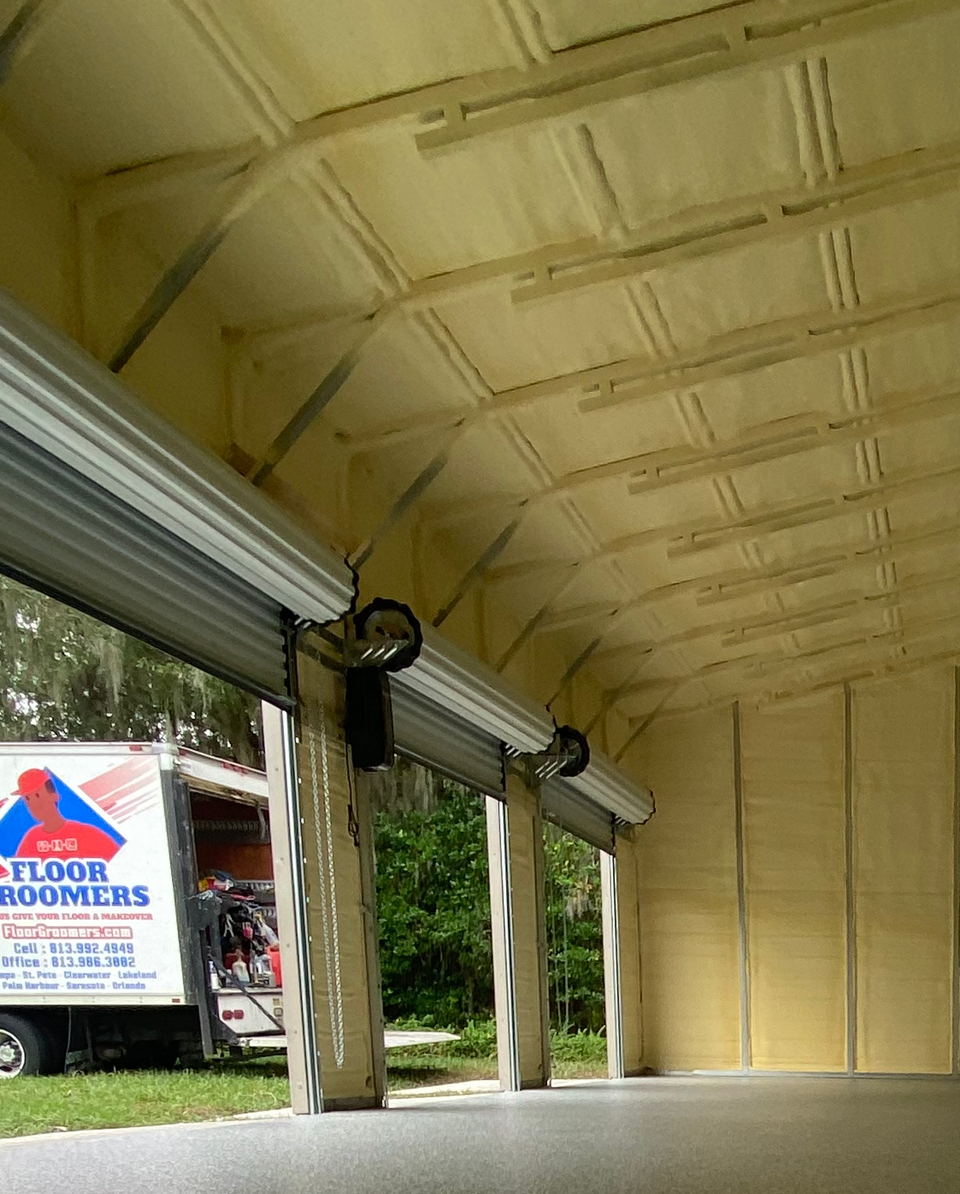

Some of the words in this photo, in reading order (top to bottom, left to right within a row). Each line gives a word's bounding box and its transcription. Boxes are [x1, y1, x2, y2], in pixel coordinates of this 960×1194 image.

[10, 861, 109, 882] FLOOR
[12, 913, 34, 921] GIVE
[35, 913, 60, 921] YOUR
[61, 913, 91, 921] FLOOR
[93, 913, 99, 921] A
[101, 913, 153, 921] MAKEOVER
[3, 924, 132, 939] FloorGroomers.com
[14, 942, 38, 954] Cell
[49, 942, 134, 954] 813.992.4949
[2, 956, 40, 968] Office
[23, 971, 35, 979] St.
[37, 971, 57, 979] Pete
[63, 971, 111, 979] Clearwater
[118, 971, 157, 979] Lakeland
[2, 981, 23, 990] Palm
[25, 981, 59, 990] Harbour
[66, 981, 105, 990] Sarasota
[112, 981, 146, 990] Orlando
